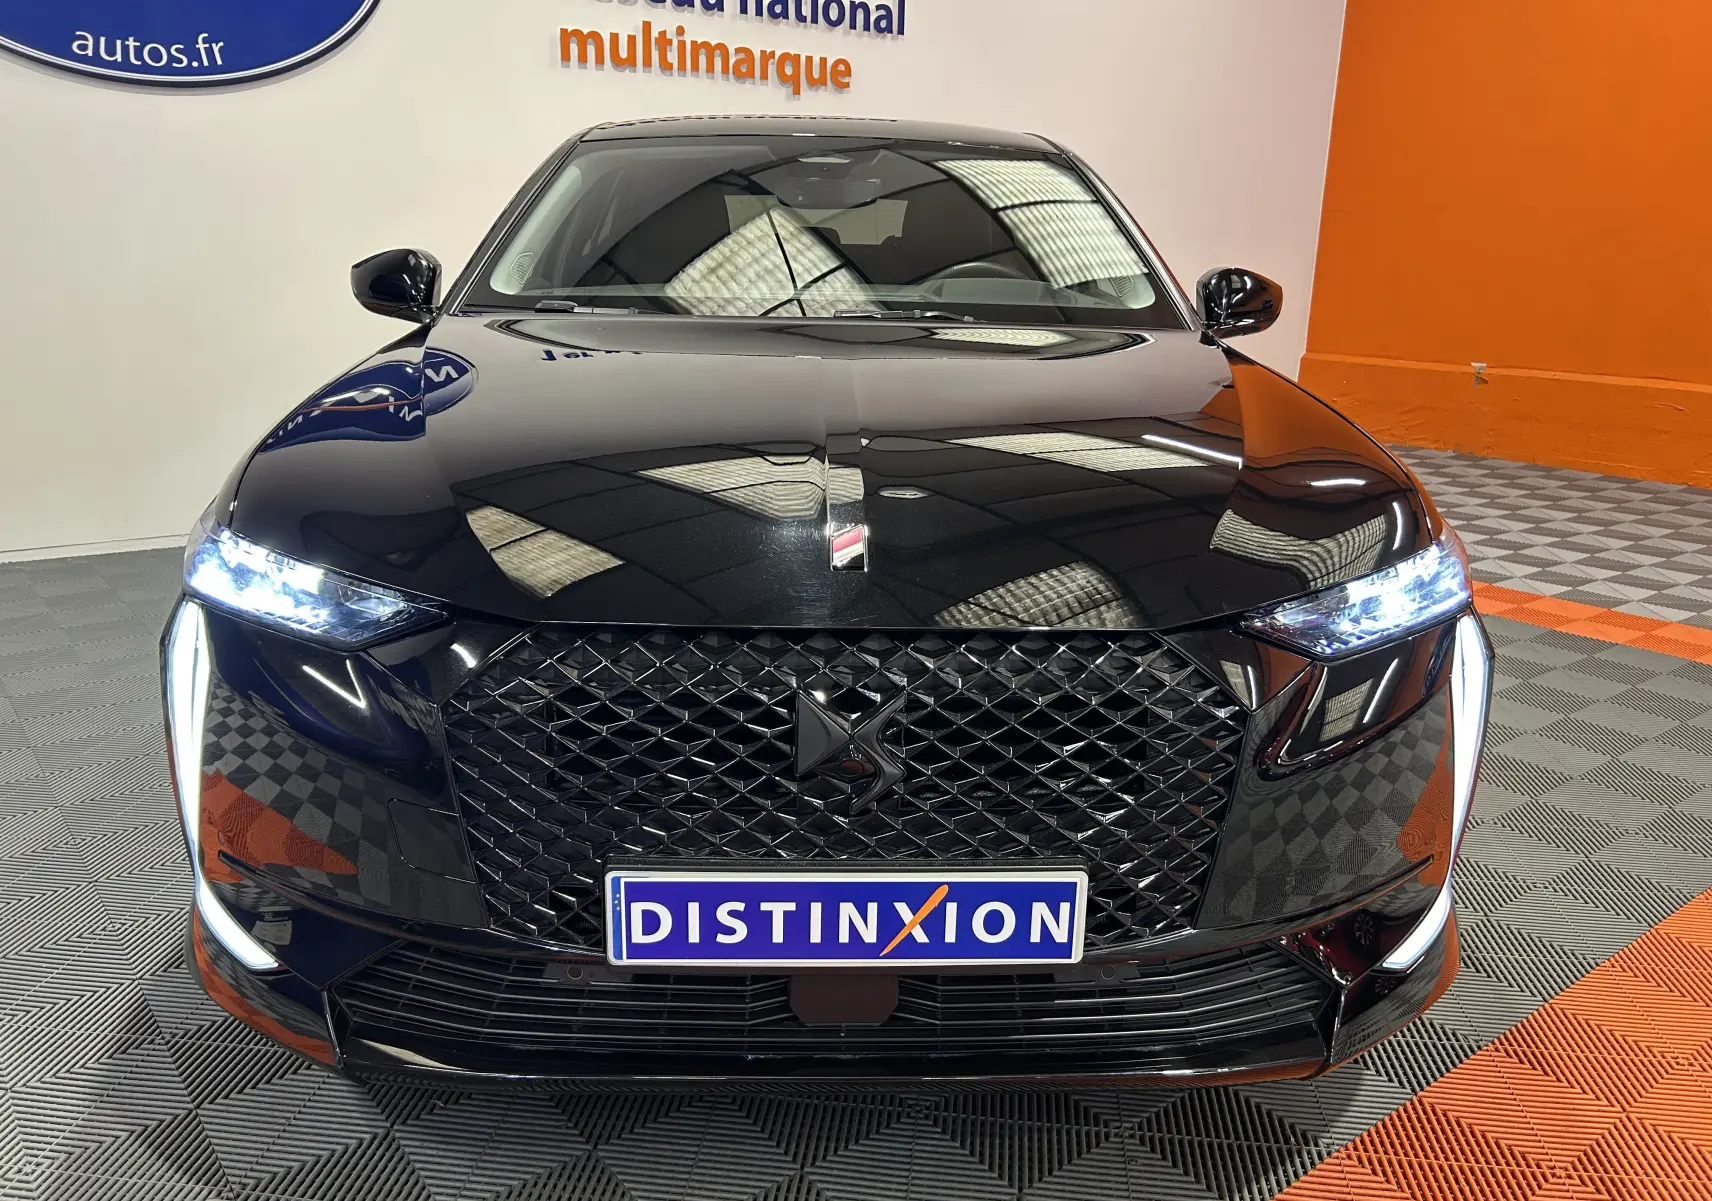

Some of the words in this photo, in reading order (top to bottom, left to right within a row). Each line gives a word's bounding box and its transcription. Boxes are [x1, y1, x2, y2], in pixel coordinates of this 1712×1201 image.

[739, 0, 905, 36] national
[71, 30, 225, 68] autos.fr
[559, 20, 852, 96] multimarque
[629, 884, 1072, 957] DISTINXION
